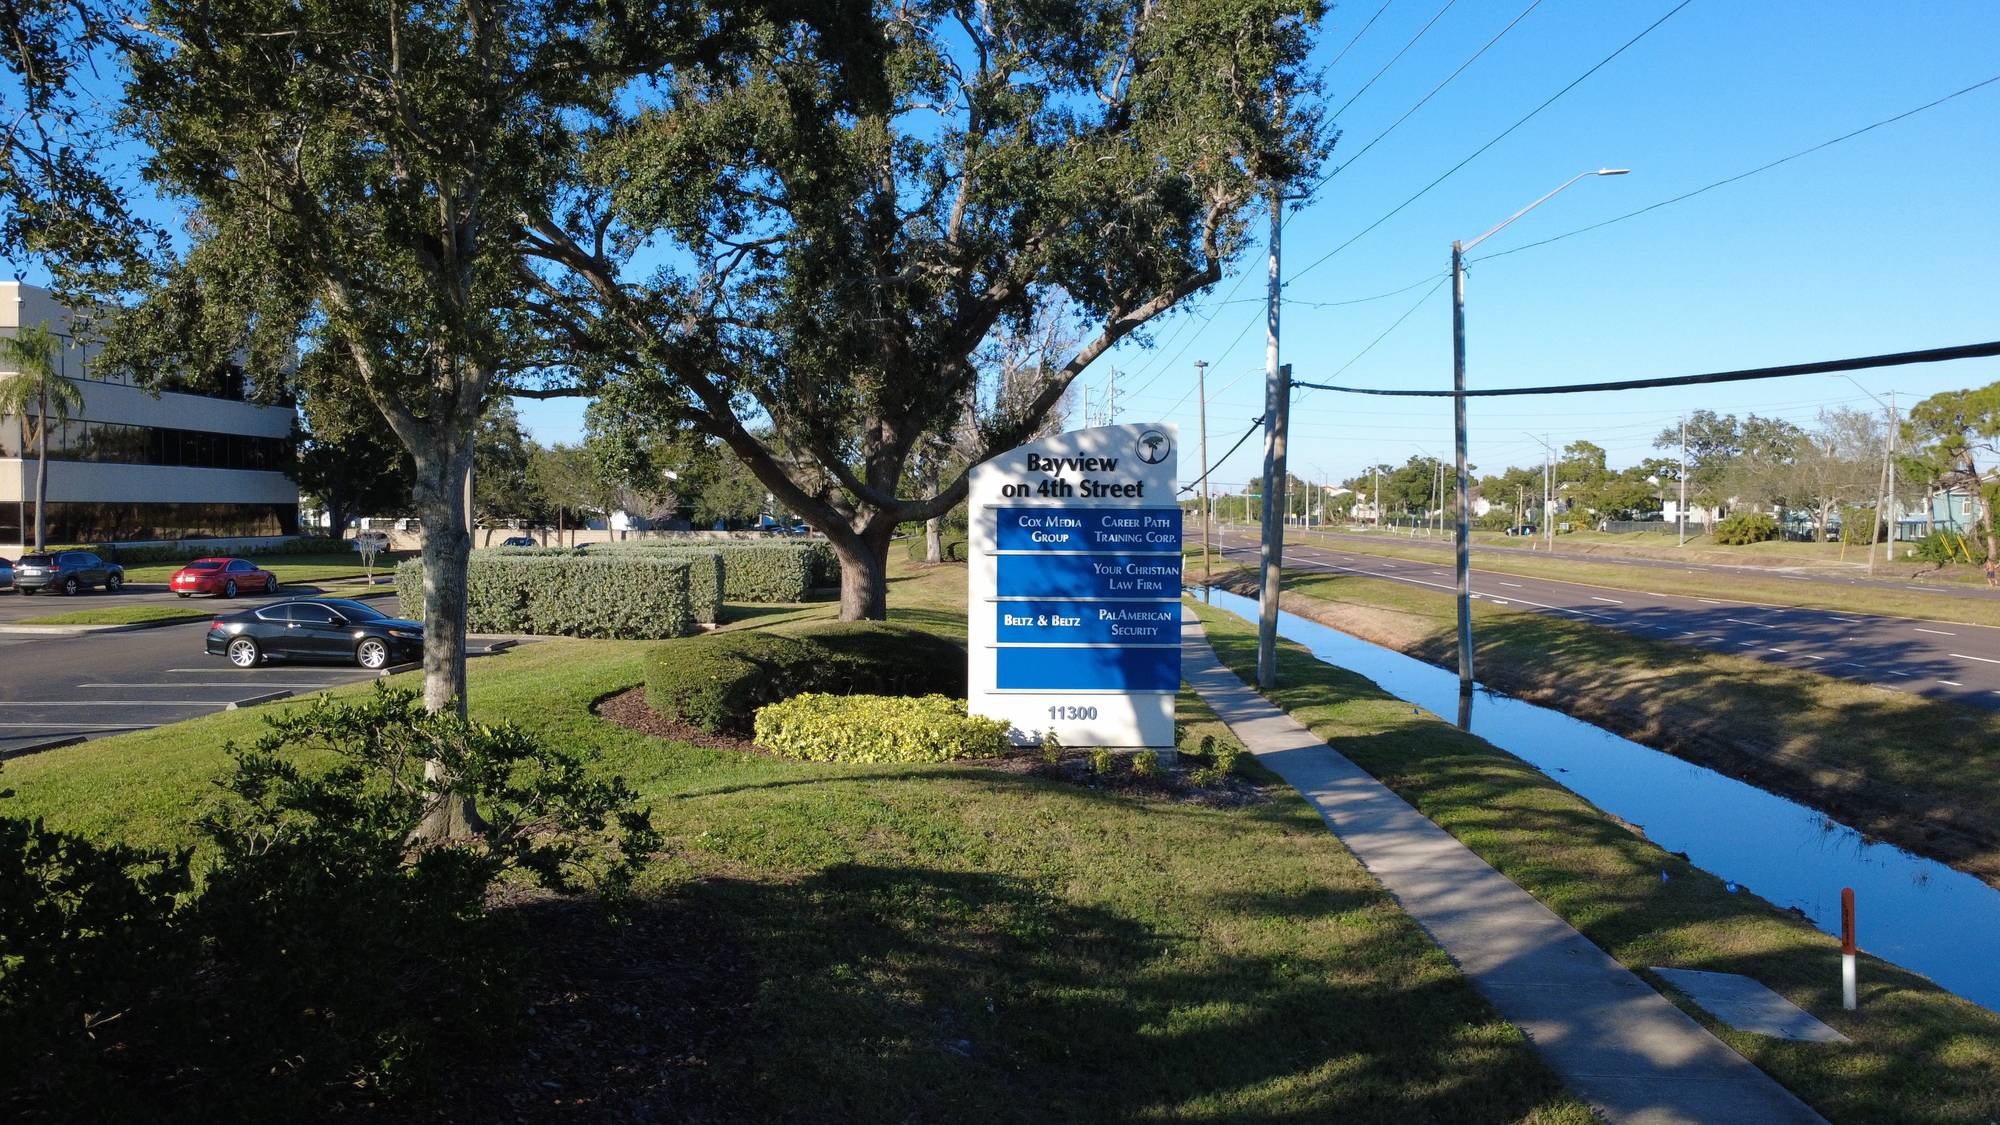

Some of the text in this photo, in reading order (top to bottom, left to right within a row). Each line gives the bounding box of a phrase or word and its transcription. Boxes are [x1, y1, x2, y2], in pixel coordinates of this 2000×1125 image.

[1026, 452, 1118, 477] Bayview
[1002, 478, 1144, 498] on 4th Street
[1018, 516, 1082, 528] COX MEDIA
[1101, 516, 1170, 528] CAREER PATH
[1032, 531, 1069, 543] GROUP
[1095, 531, 1176, 543] TRAINING CORP.
[1093, 563, 1179, 575] YOUR CHRISTIAN
[1109, 578, 1161, 590] LAW FIRM
[1004, 615, 1080, 626] BELTZ & BELTZ
[1099, 609, 1172, 621] PALAMERICAN
[1111, 624, 1158, 636] SECURITY
[1048, 706, 1097, 720] 11300
